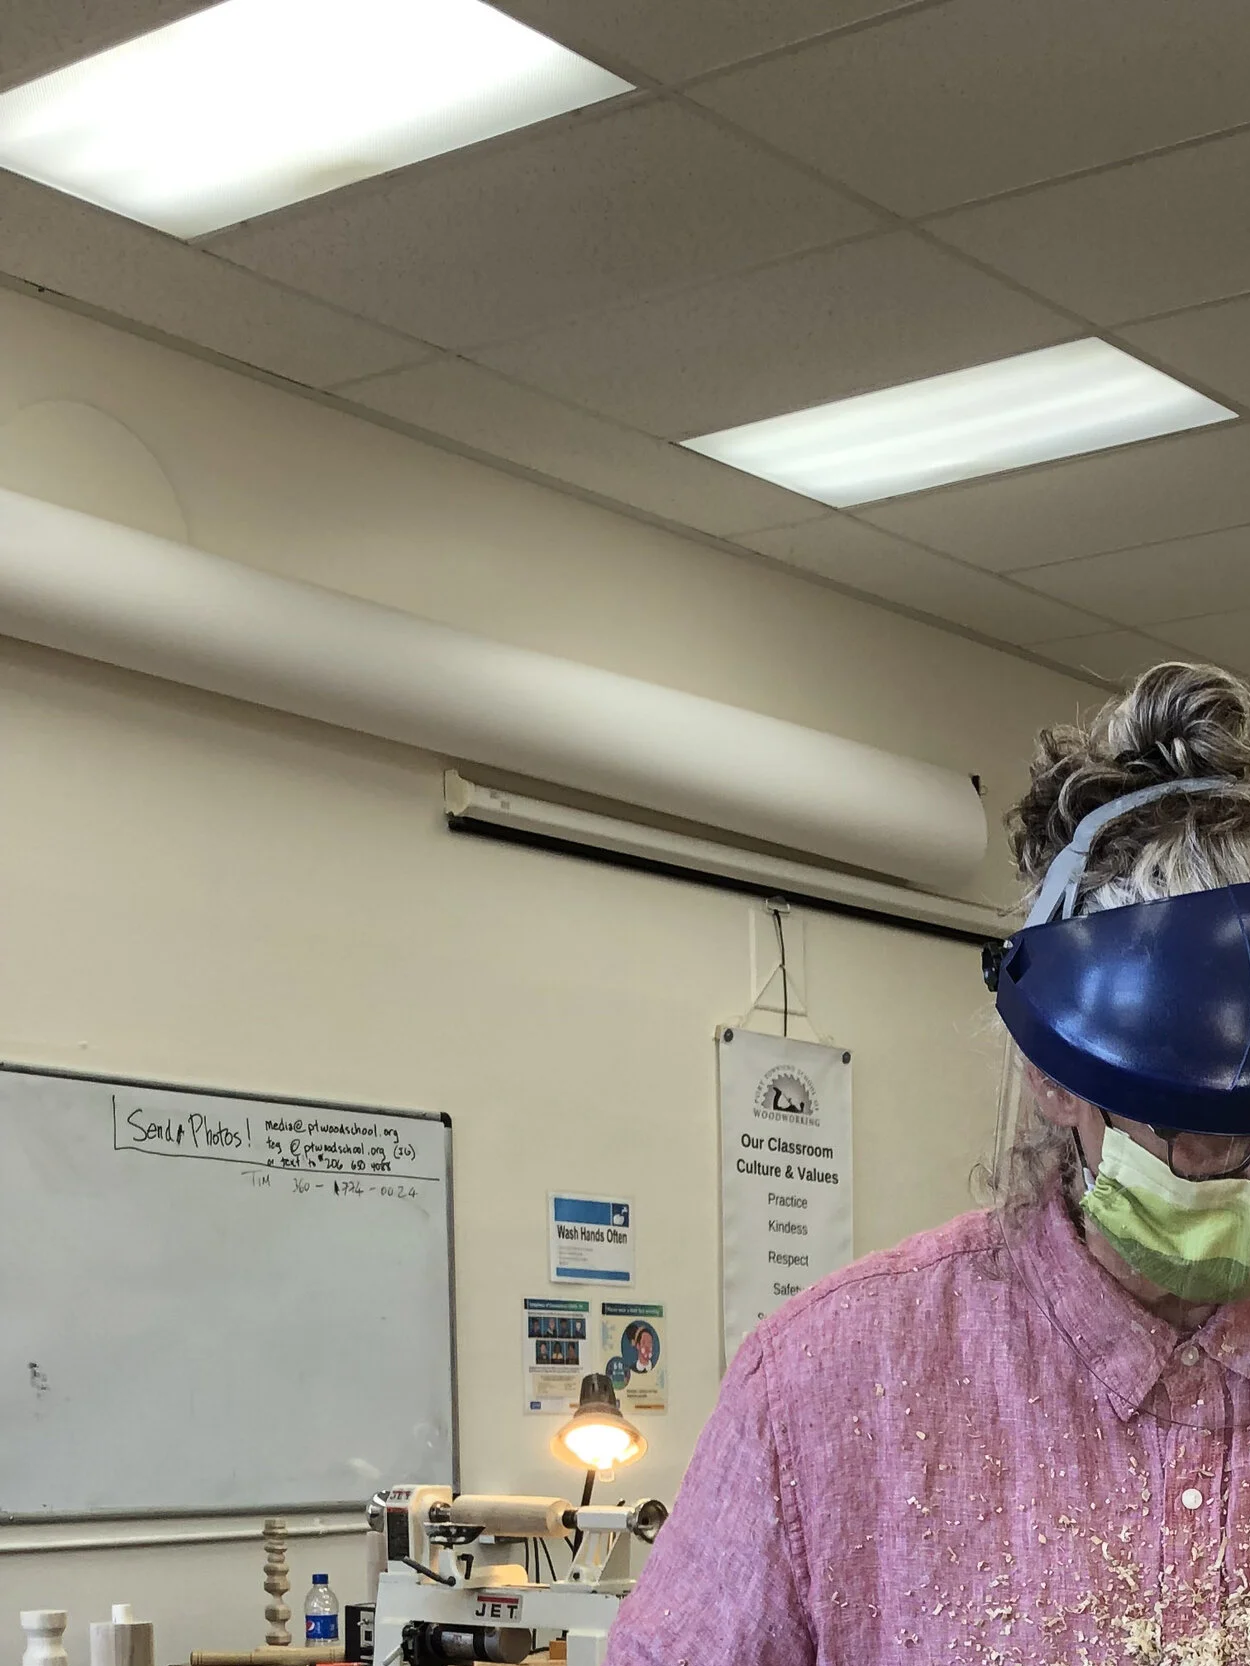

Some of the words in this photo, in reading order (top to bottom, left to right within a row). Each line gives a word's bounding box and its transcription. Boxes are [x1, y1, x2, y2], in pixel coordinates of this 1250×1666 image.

[753, 1108, 821, 1127] WOODWORKING
[127, 1109, 174, 1142] Send
[188, 1113, 251, 1148] Photos!
[741, 1133, 764, 1150] Our
[768, 1137, 834, 1159] Classroom
[736, 1159, 782, 1178] Culture
[785, 1165, 794, 1180] &
[797, 1166, 839, 1184] Values
[768, 1192, 808, 1209] Practice
[557, 1225, 578, 1240] Wash
[580, 1226, 605, 1242] Hands
[607, 1228, 627, 1244] Often
[768, 1220, 808, 1236] Kindess
[768, 1250, 809, 1267] Respect
[475, 1603, 518, 1619] JET
